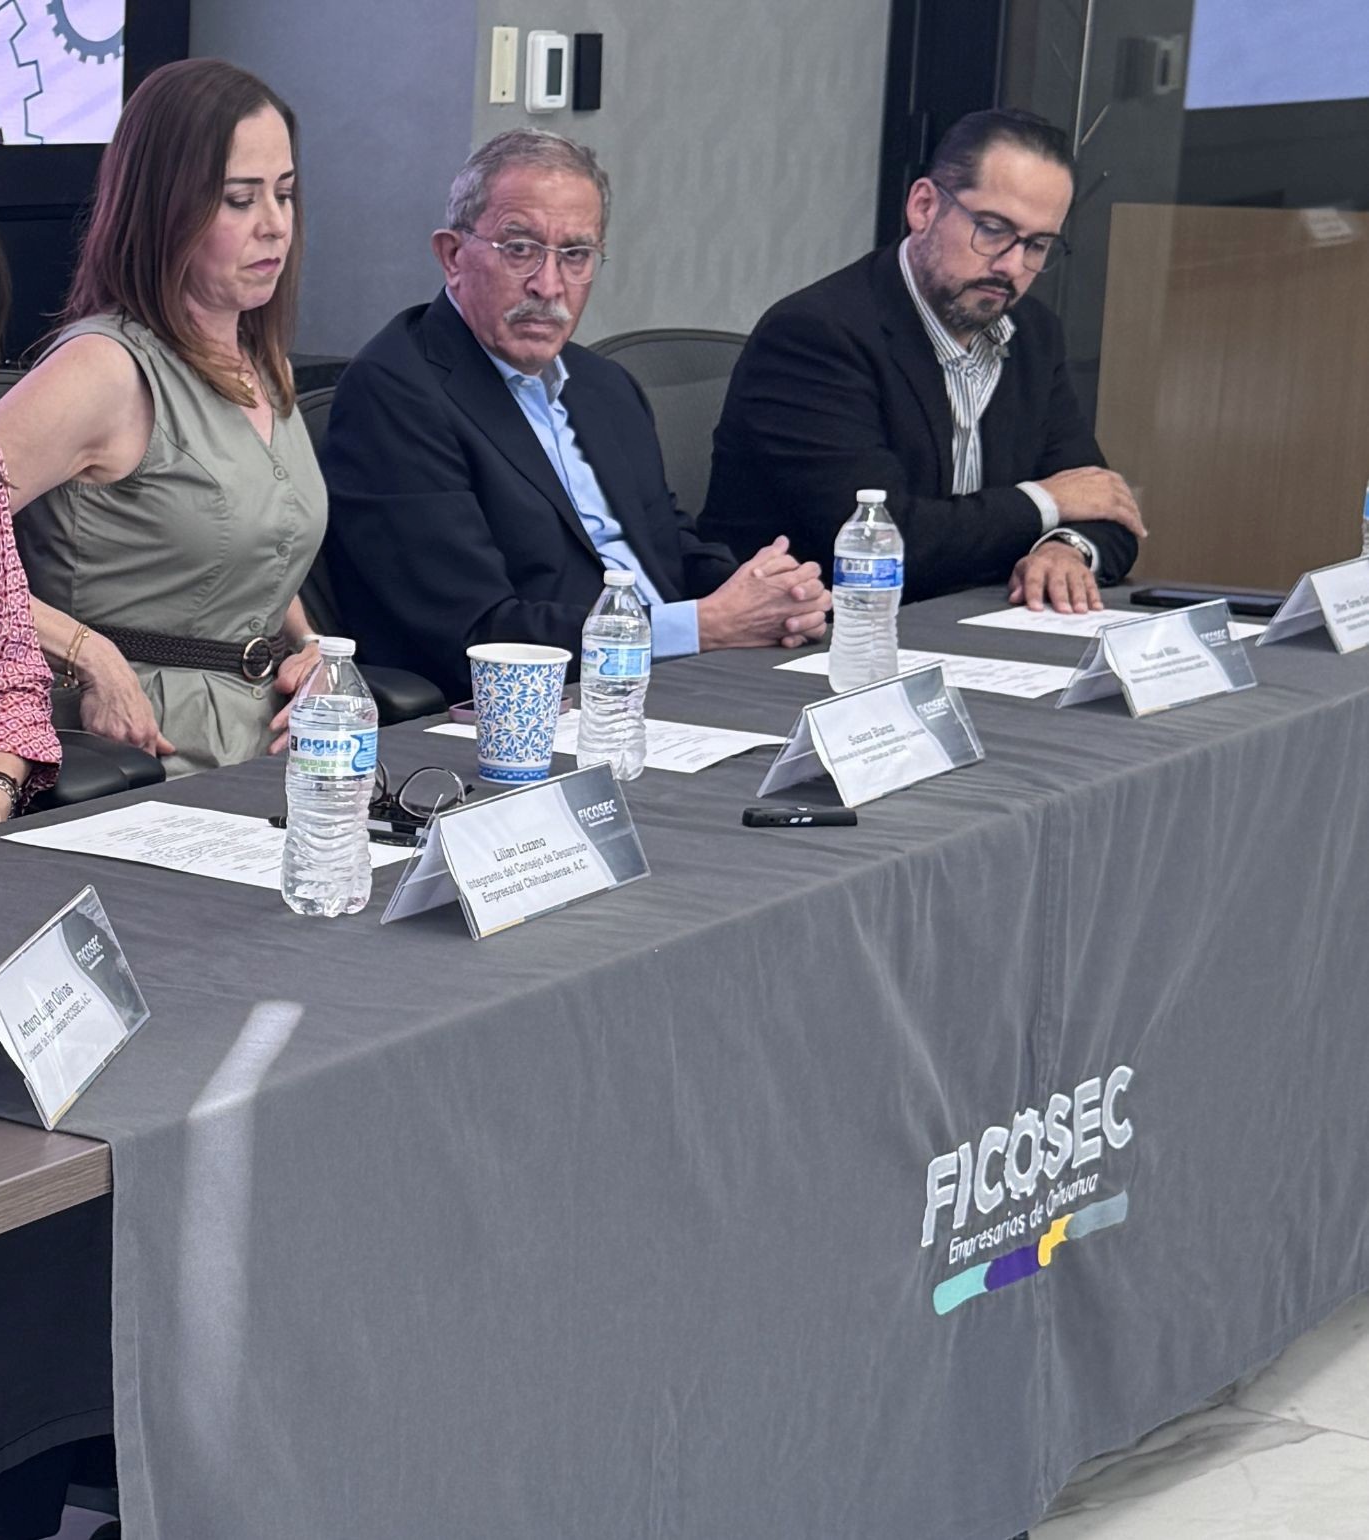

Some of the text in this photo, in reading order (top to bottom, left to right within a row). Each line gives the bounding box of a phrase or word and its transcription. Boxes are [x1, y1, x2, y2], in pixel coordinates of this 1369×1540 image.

[300, 737, 351, 757] agua
[577, 799, 617, 824] FICOSEC
[493, 838, 546, 862] Lilian Lozano
[466, 842, 587, 890] Integrante del Consejo de Desarrollo
[481, 880, 524, 904] Empresarial
[76, 934, 103, 967] FICOSEC
[18, 1014, 41, 1040] Arturo
[920, 1065, 1134, 1248] FICOSEC
[949, 1210, 1026, 1265] Empresarios
[1029, 1199, 1043, 1229] de
